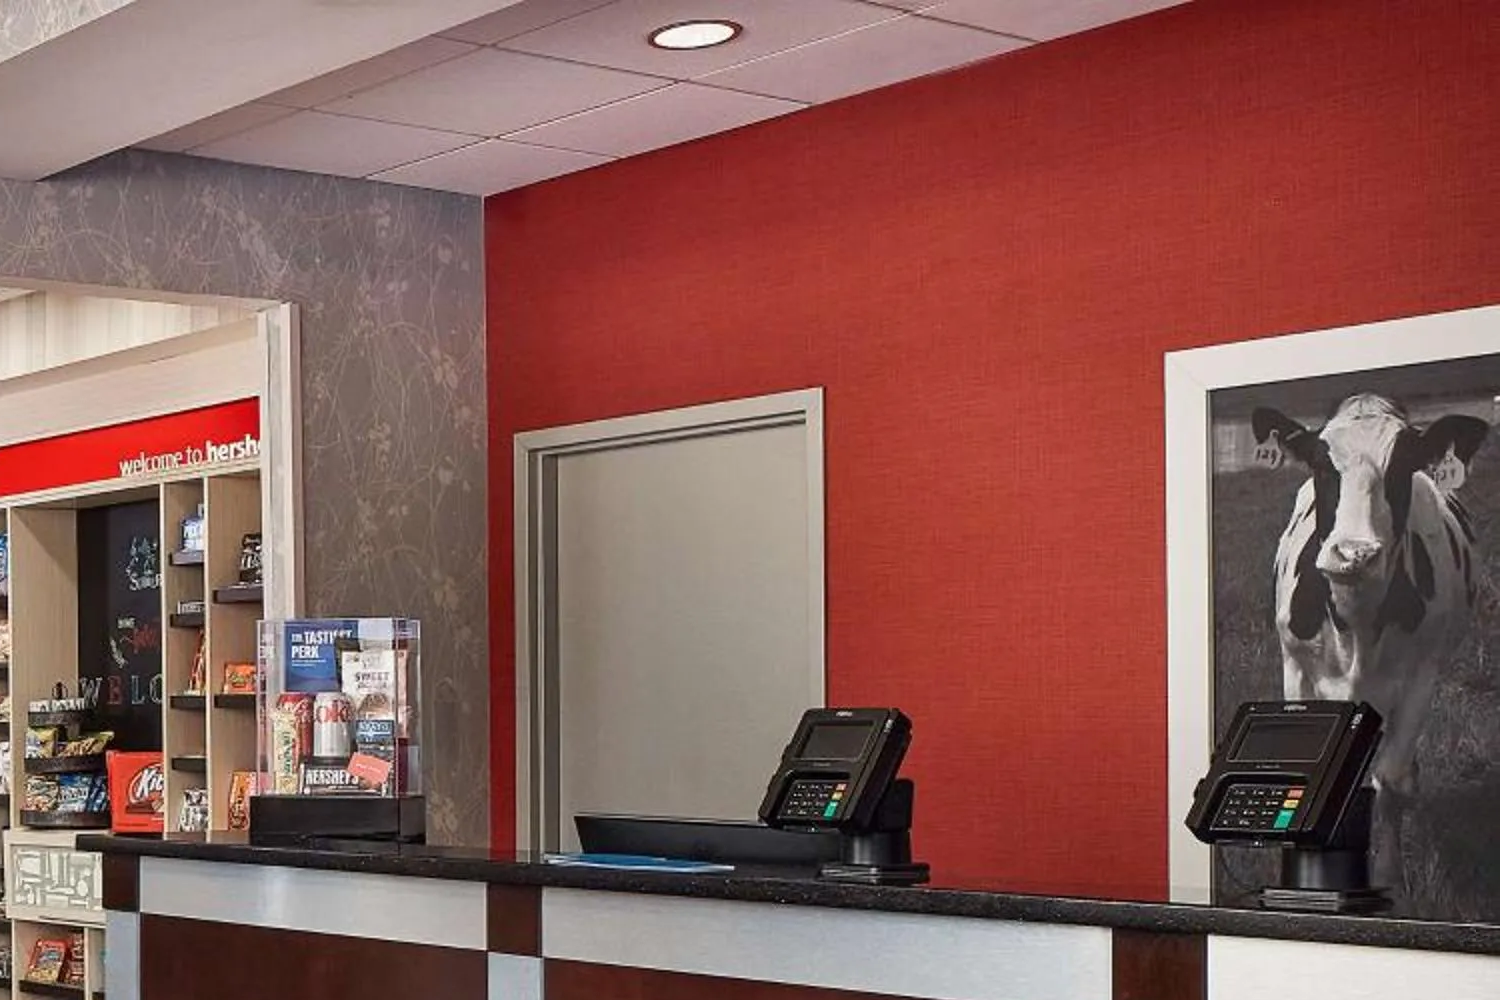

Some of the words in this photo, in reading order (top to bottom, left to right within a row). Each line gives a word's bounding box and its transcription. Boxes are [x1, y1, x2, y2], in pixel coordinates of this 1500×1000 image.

[119, 451, 183, 477] welcome
[185, 445, 203, 465] to
[206, 433, 261, 463] hersh
[291, 645, 320, 659] PERK
